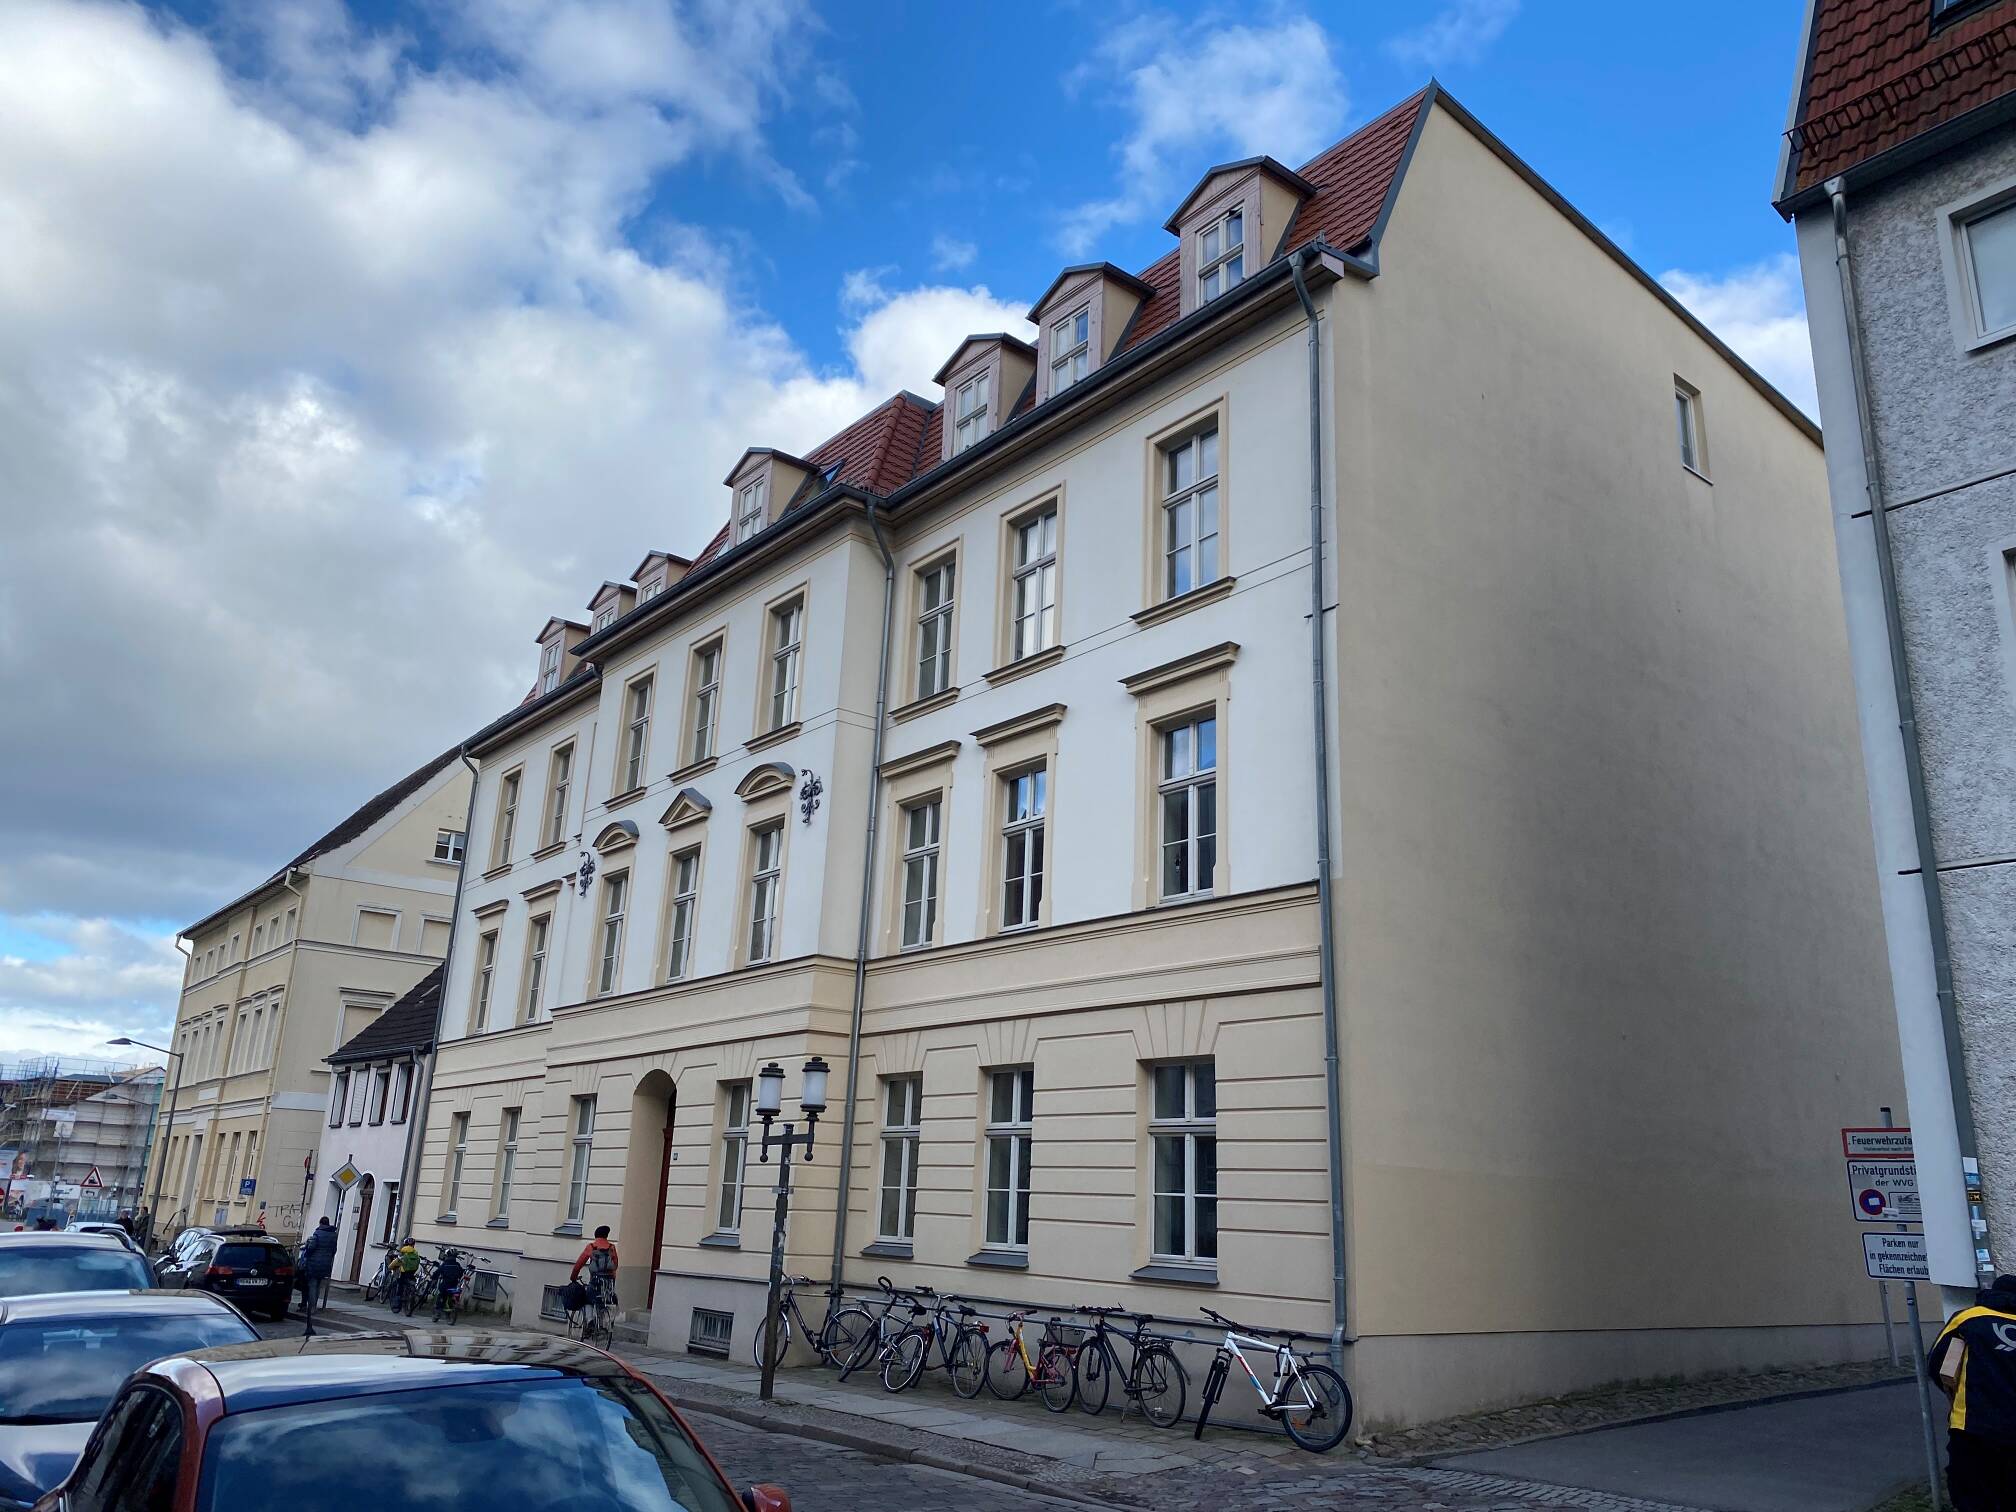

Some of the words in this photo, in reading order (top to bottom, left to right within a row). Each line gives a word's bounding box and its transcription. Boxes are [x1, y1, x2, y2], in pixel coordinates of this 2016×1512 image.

[1852, 1136, 1912, 1145] Feuerwehrzufa
[1875, 1179, 1890, 1187] der
[1893, 1179, 1914, 1187] WVG
[1882, 1238, 1906, 1248] Parken
[1907, 1240, 1919, 1249] nur
[1879, 1264, 1905, 1274] Flächen
[1906, 1265, 1929, 1276] erlaub
